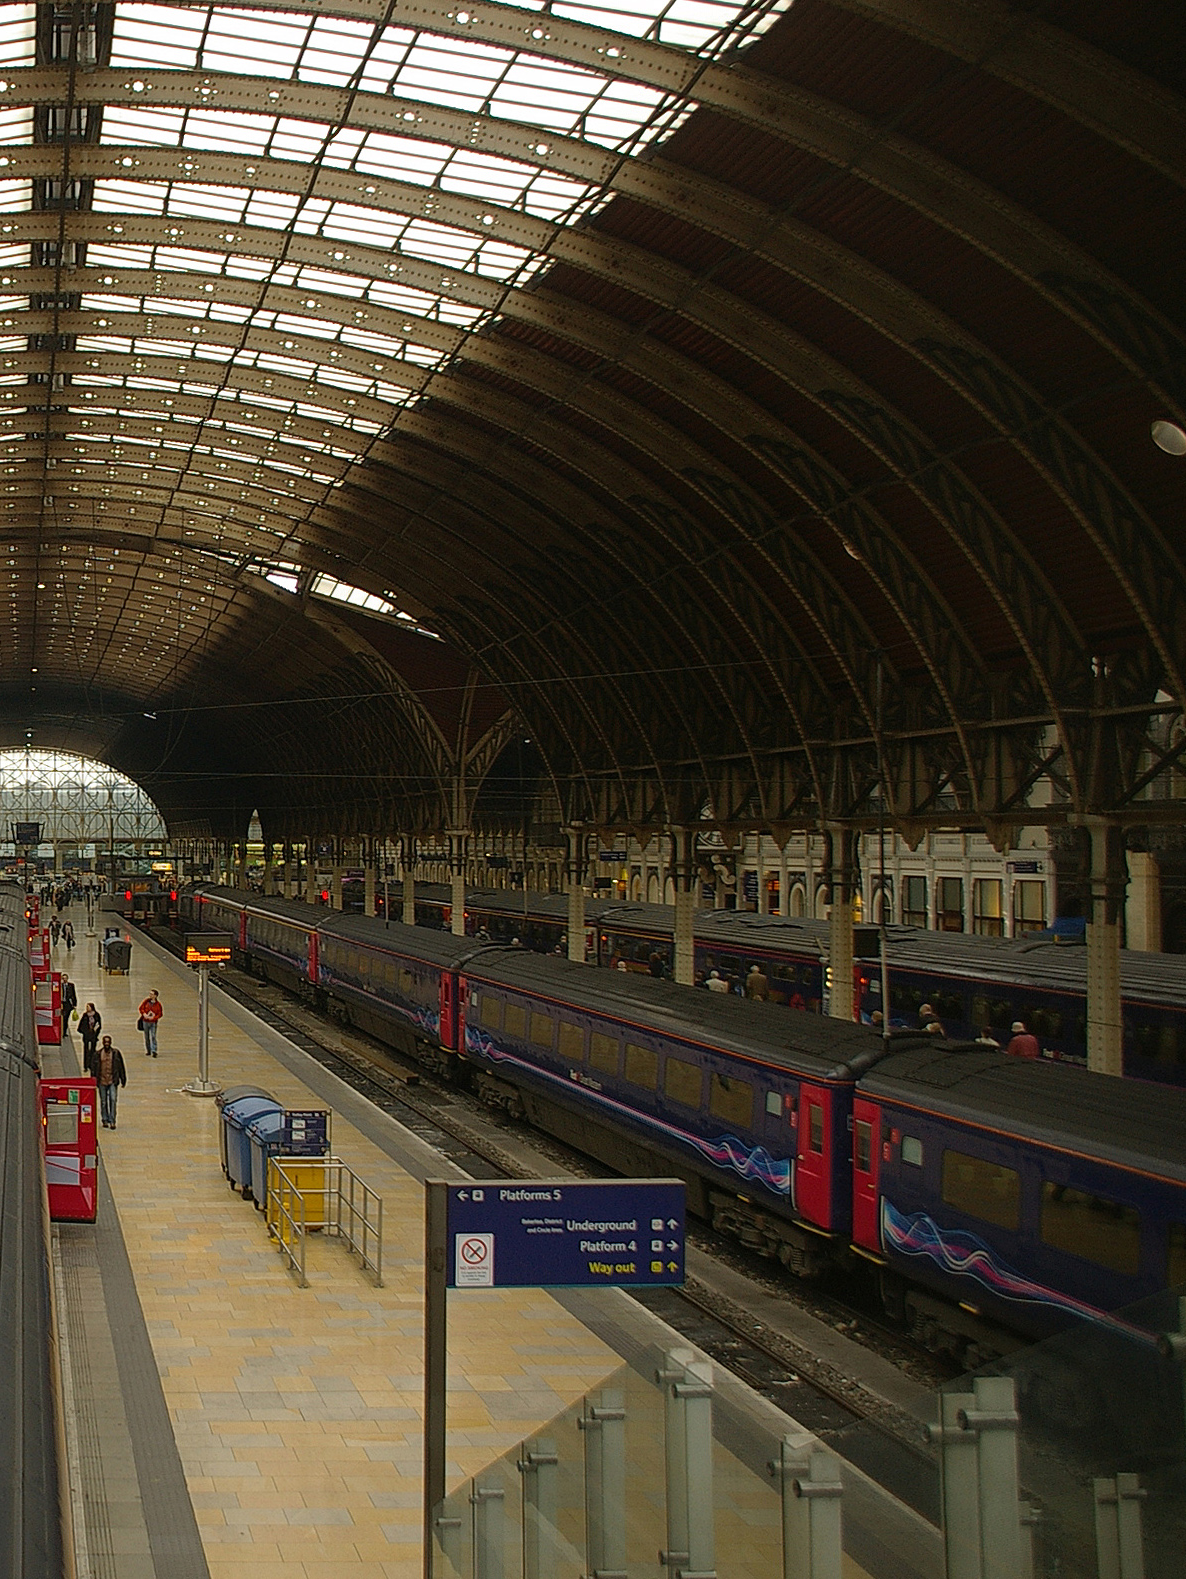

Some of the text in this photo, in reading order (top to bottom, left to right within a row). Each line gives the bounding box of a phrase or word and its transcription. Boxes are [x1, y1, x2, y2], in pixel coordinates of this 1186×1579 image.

[499, 1189, 562, 1201] Platforms 5
[566, 1219, 636, 1233] Underground
[580, 1240, 637, 1252] Platform 4
[589, 1262, 636, 1275] Way out
